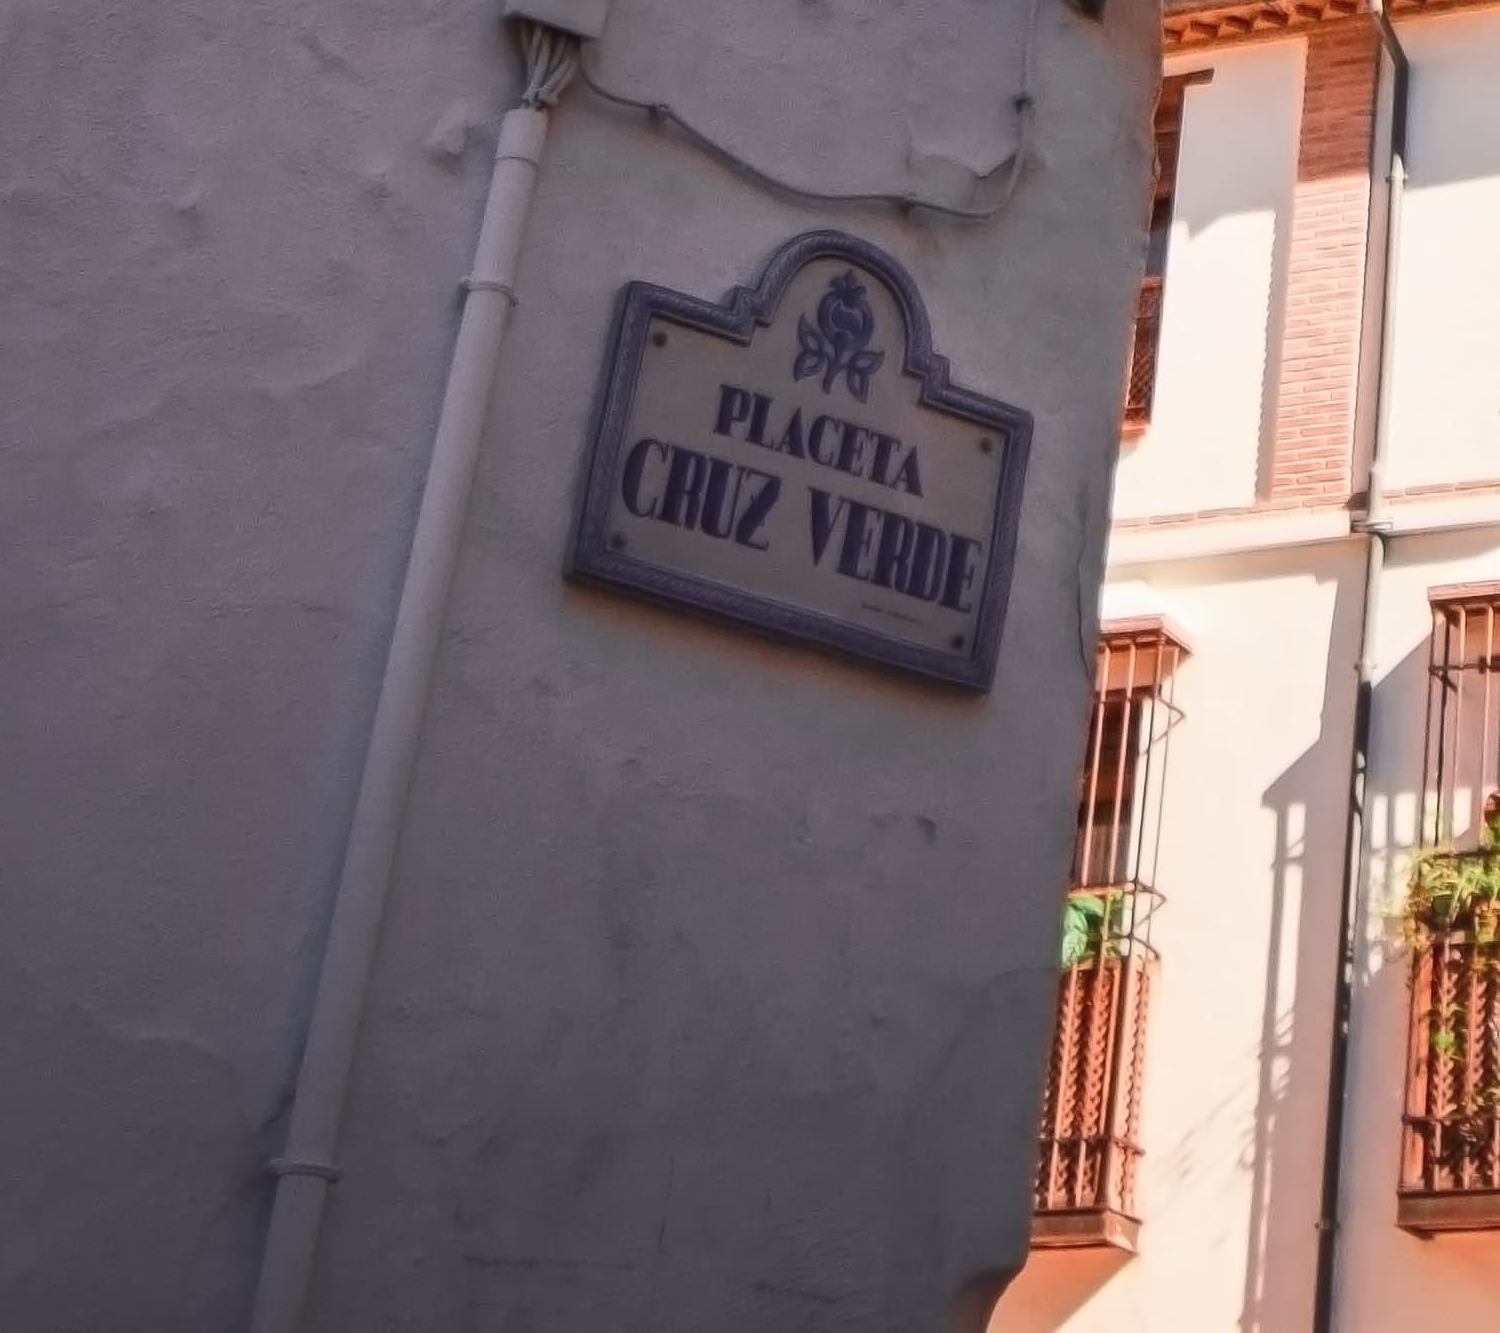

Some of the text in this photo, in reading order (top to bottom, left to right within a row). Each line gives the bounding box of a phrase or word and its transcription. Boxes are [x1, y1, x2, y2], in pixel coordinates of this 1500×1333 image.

[714, 384, 924, 497] PLACETA
[622, 438, 982, 613] CRUZ VERDE
